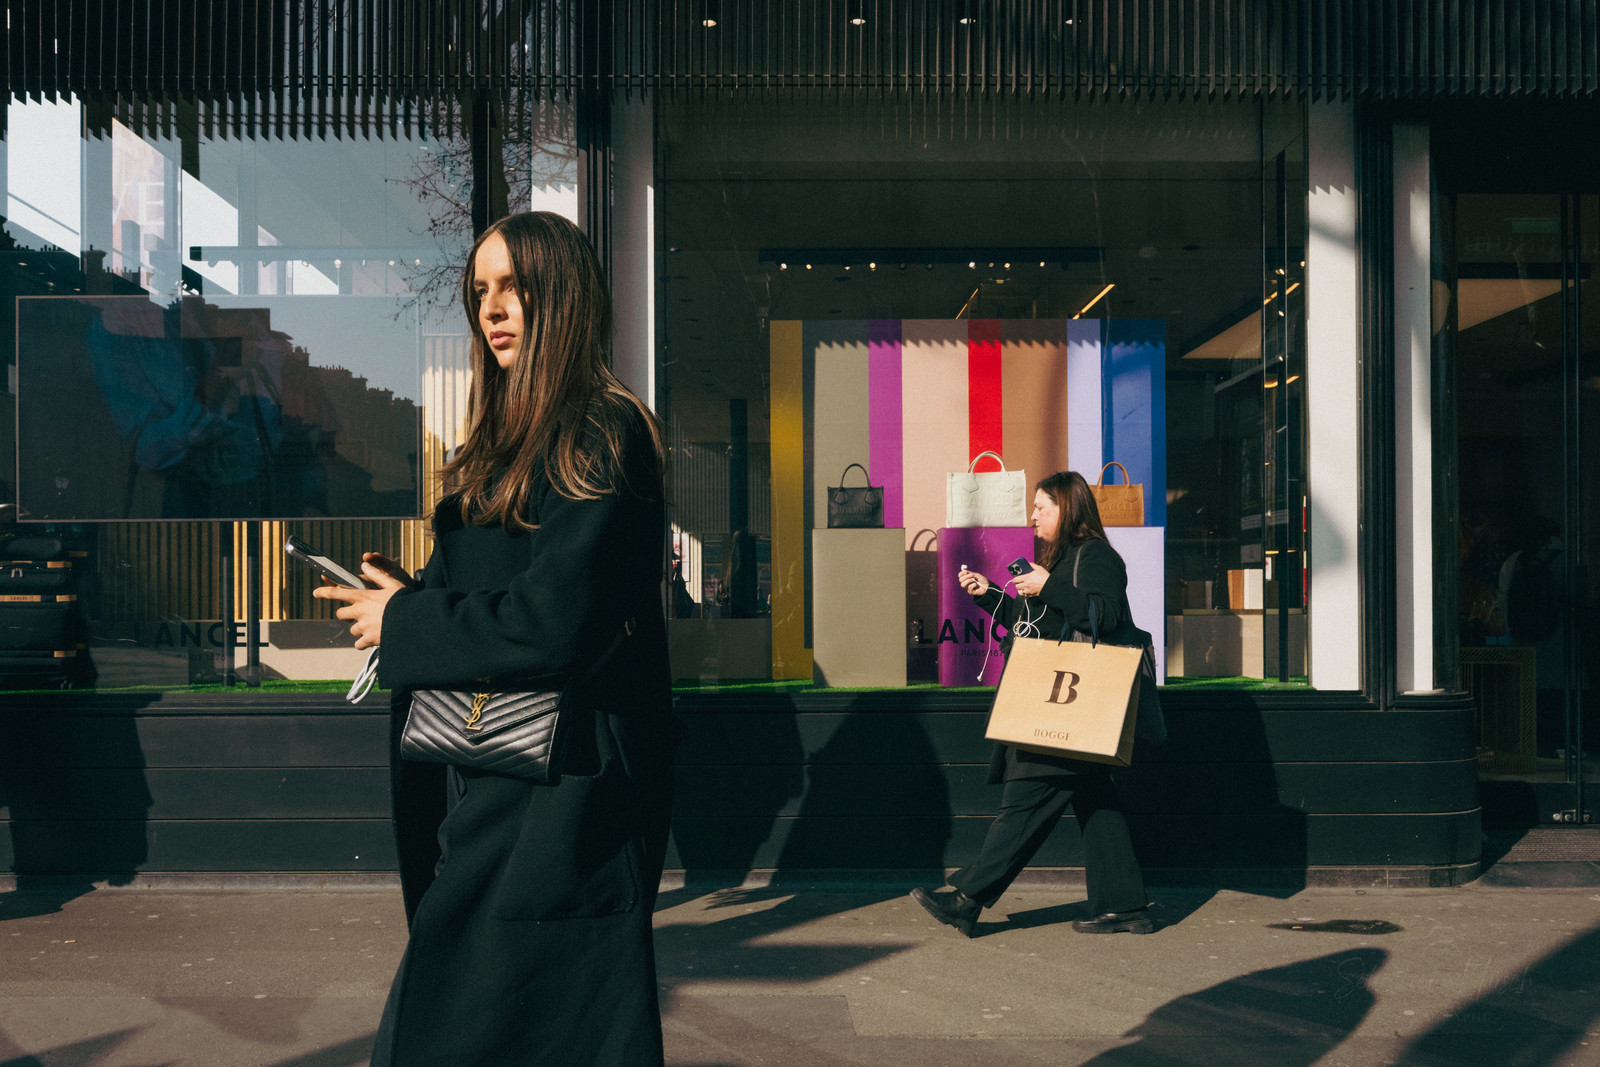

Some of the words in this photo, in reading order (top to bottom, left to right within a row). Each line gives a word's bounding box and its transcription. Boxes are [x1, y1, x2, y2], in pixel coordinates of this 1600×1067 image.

[918, 619, 1008, 644] LANC
[1045, 670, 1080, 705] B
[1033, 728, 1070, 741] BOGGI
